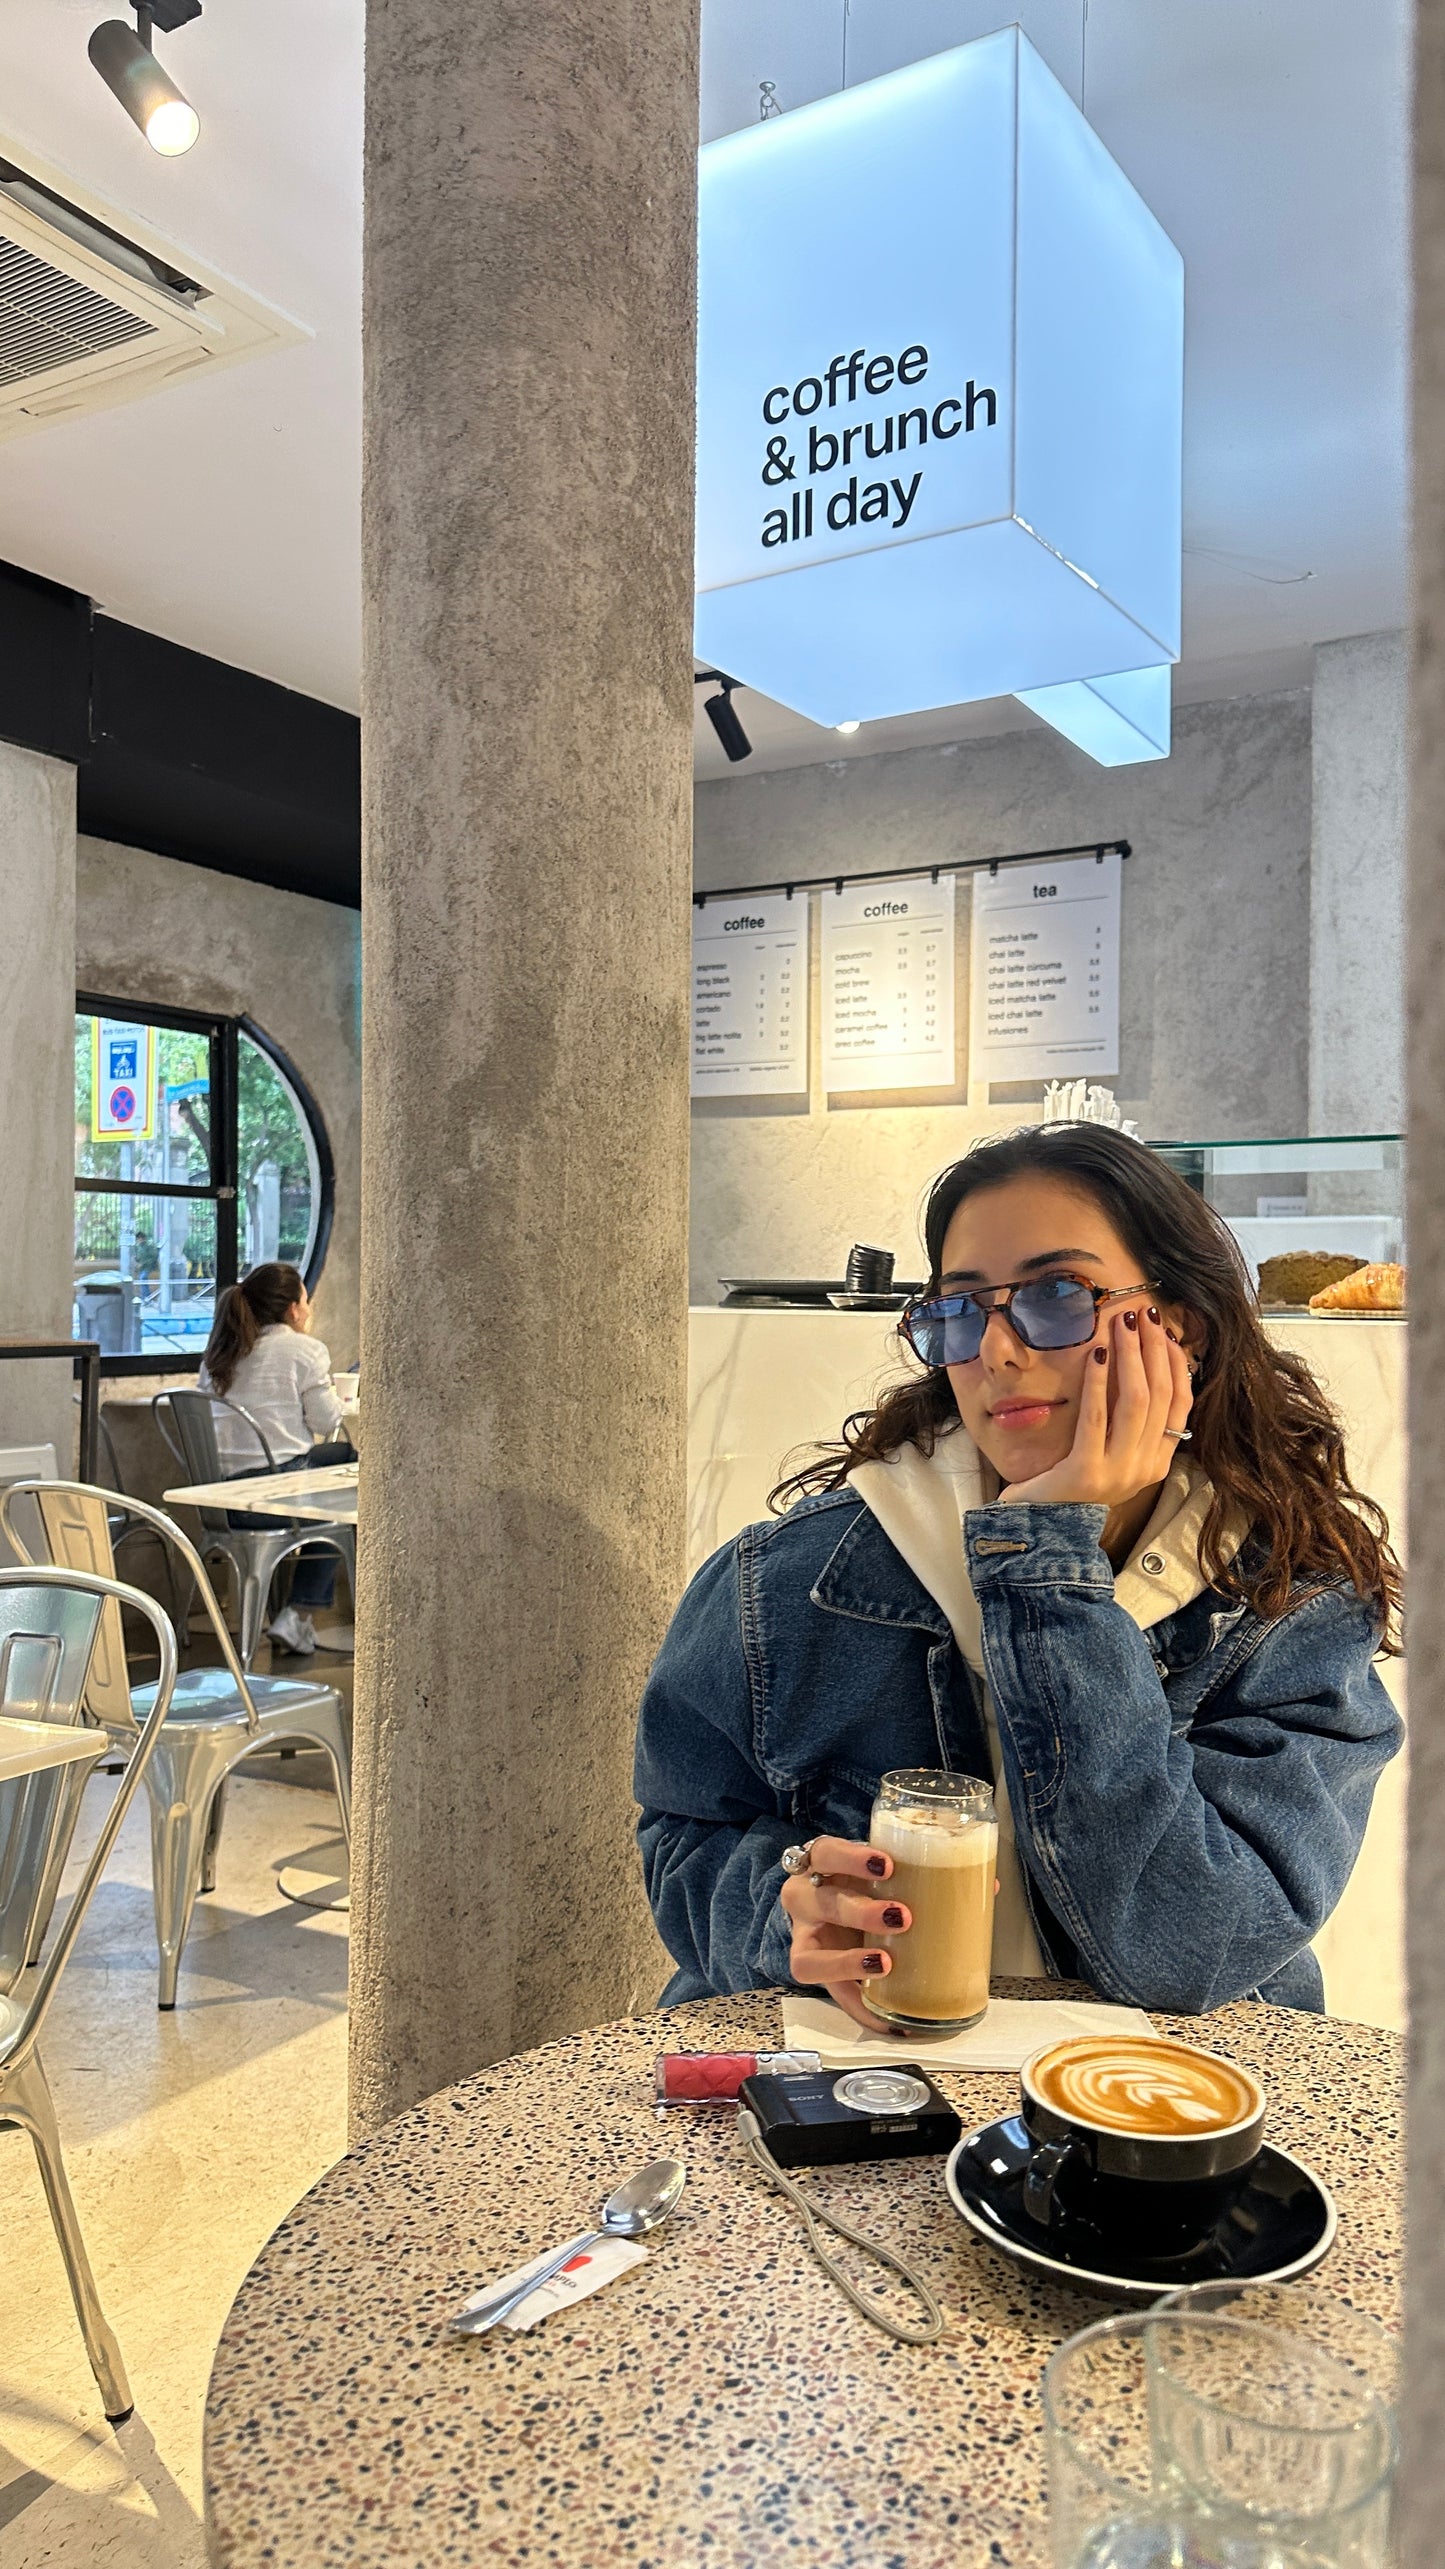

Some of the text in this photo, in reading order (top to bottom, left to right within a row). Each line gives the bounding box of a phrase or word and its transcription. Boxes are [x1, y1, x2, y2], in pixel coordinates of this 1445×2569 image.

[763, 344, 929, 425] coffee
[761, 380, 997, 486] & brunch
[761, 471, 923, 548] all day
[863, 901, 909, 917] coffee
[1033, 885, 1057, 898] tea
[724, 916, 765, 931] coffee
